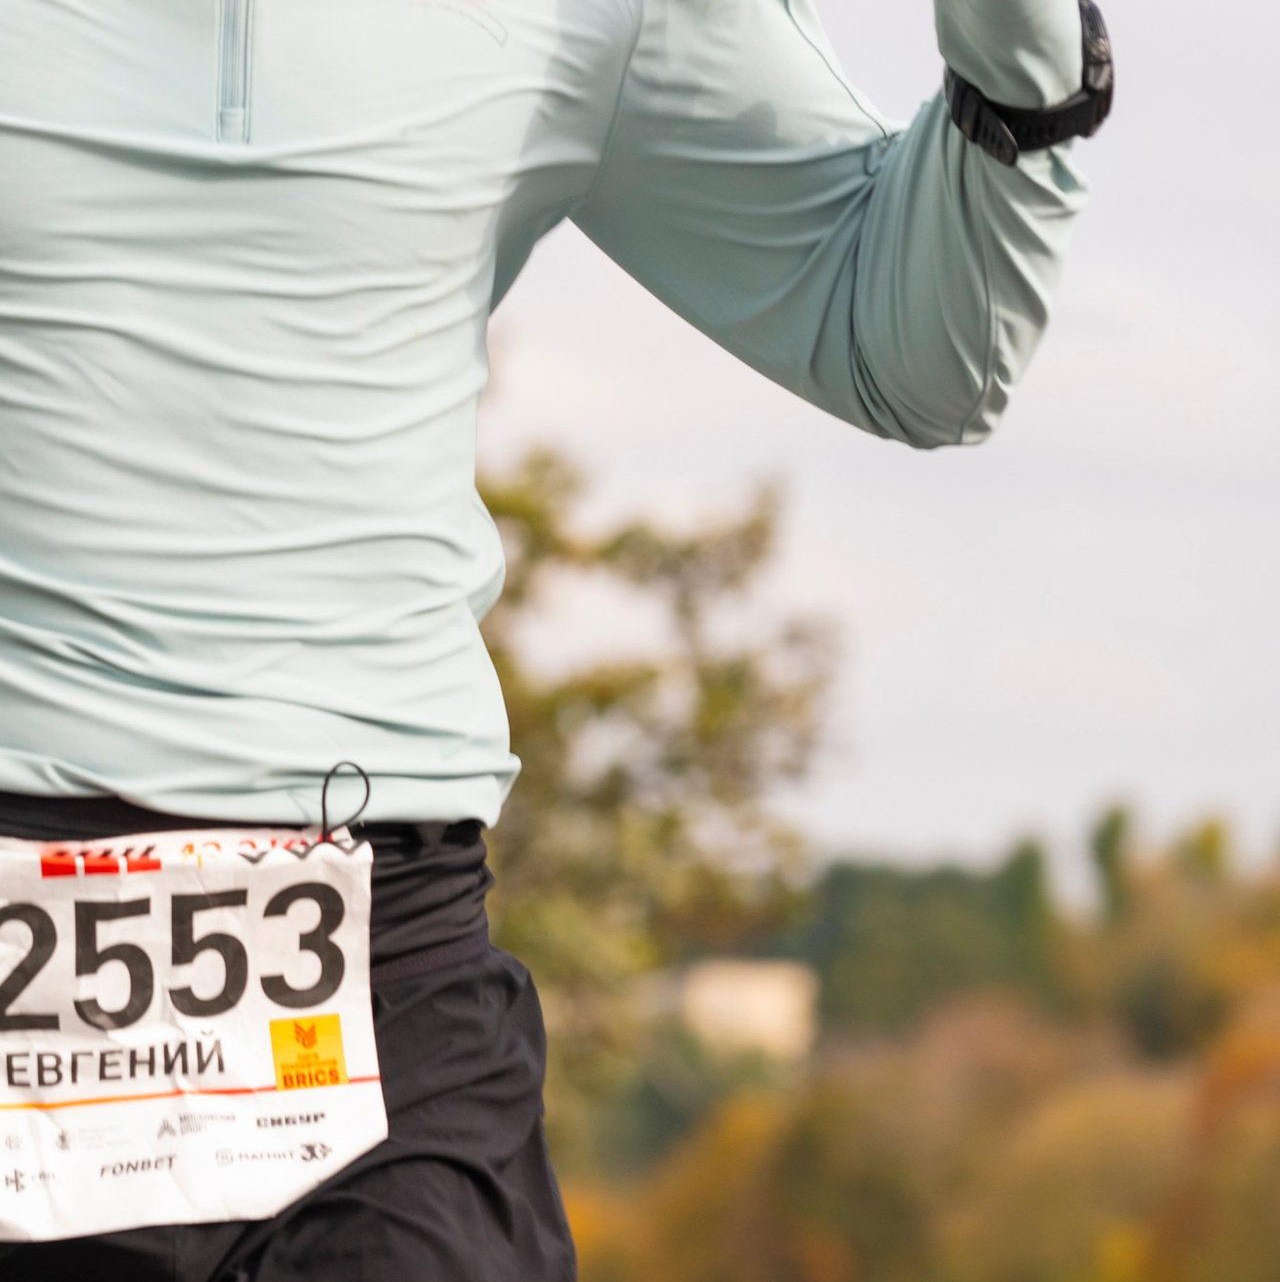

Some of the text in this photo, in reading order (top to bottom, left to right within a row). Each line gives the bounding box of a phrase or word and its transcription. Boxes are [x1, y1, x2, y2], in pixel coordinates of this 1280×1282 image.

[5, 1031, 226, 1088] ЕВГЕНИЙ
[282, 1068, 340, 1090] BRICS
[99, 1154, 178, 1178] FONBET
